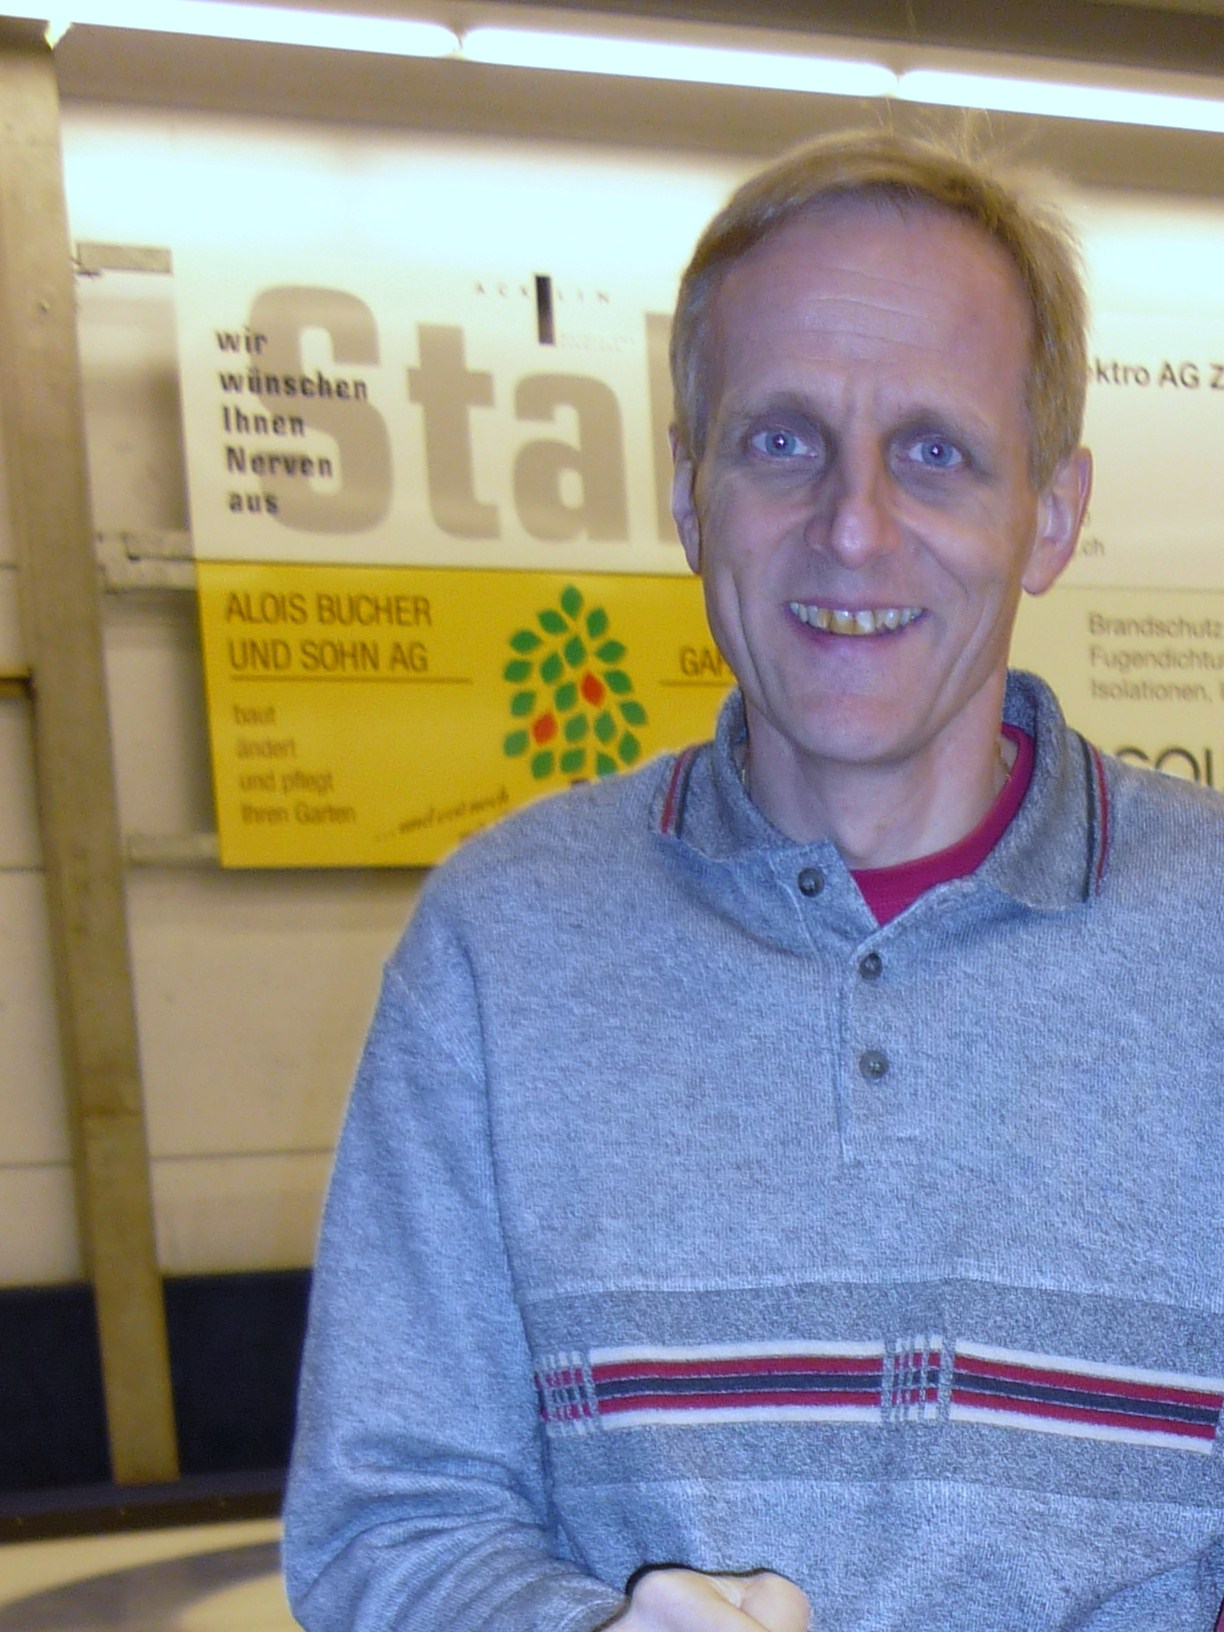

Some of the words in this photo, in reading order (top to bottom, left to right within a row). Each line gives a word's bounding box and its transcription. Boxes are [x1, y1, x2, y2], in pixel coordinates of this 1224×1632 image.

[215, 328, 267, 354] wir
[219, 368, 369, 401] wünschen
[1158, 363, 1201, 390] AG
[222, 405, 306, 437] Ihnen
[226, 446, 333, 479] Nerven
[228, 491, 279, 515] aus
[225, 592, 307, 626] ALOIS
[317, 593, 433, 628] BUCHER
[1087, 613, 1223, 639] Brandschutz
[228, 639, 291, 672] UND
[301, 640, 379, 673] SOHN
[389, 643, 429, 674] AG
